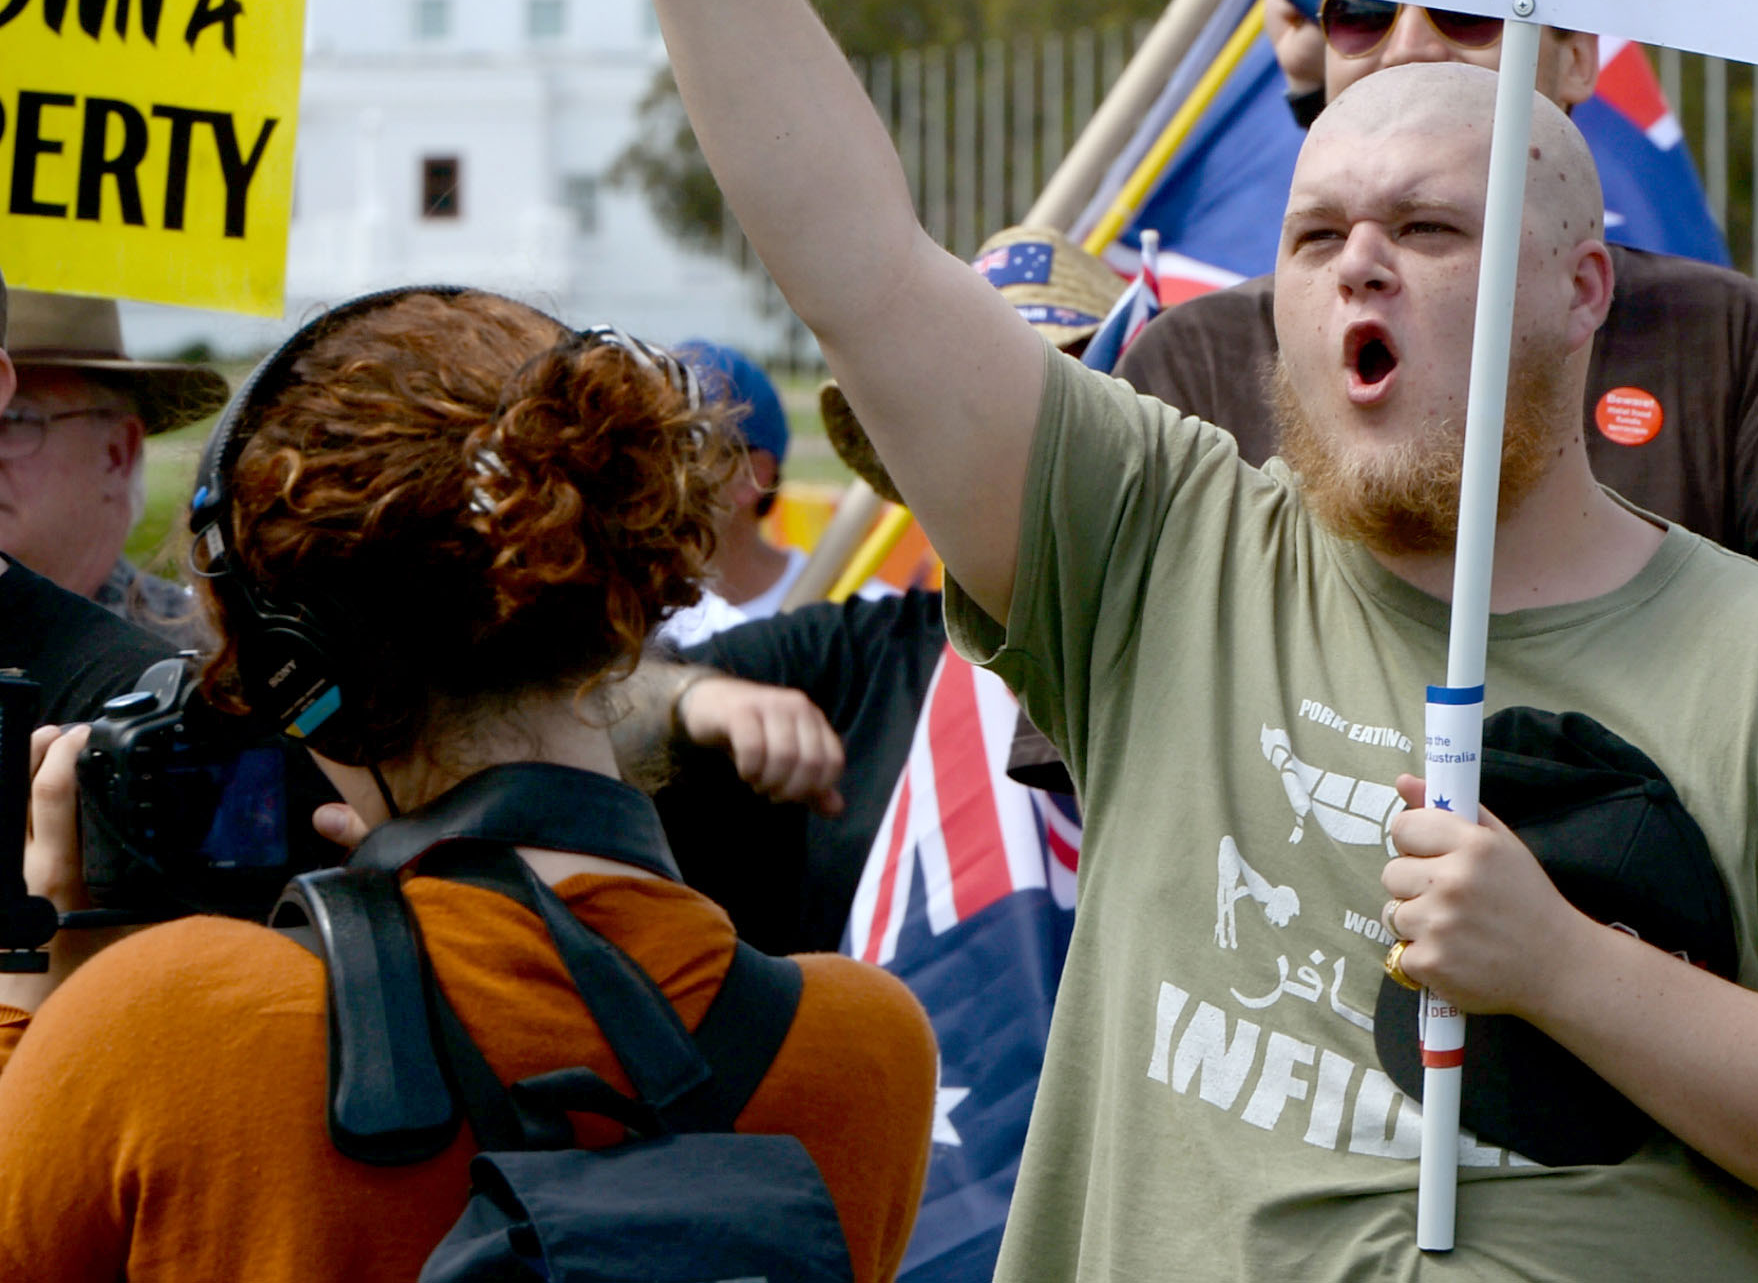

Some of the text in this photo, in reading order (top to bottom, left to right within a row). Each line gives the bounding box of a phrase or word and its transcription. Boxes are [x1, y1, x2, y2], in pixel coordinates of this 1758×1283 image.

[0, 90, 280, 238] ERTY
[1299, 699, 1413, 754] PORK EATING
[1344, 910, 1396, 947] WOM
[1231, 949, 1375, 1033] افر
[1147, 980, 1548, 1167] INFID
